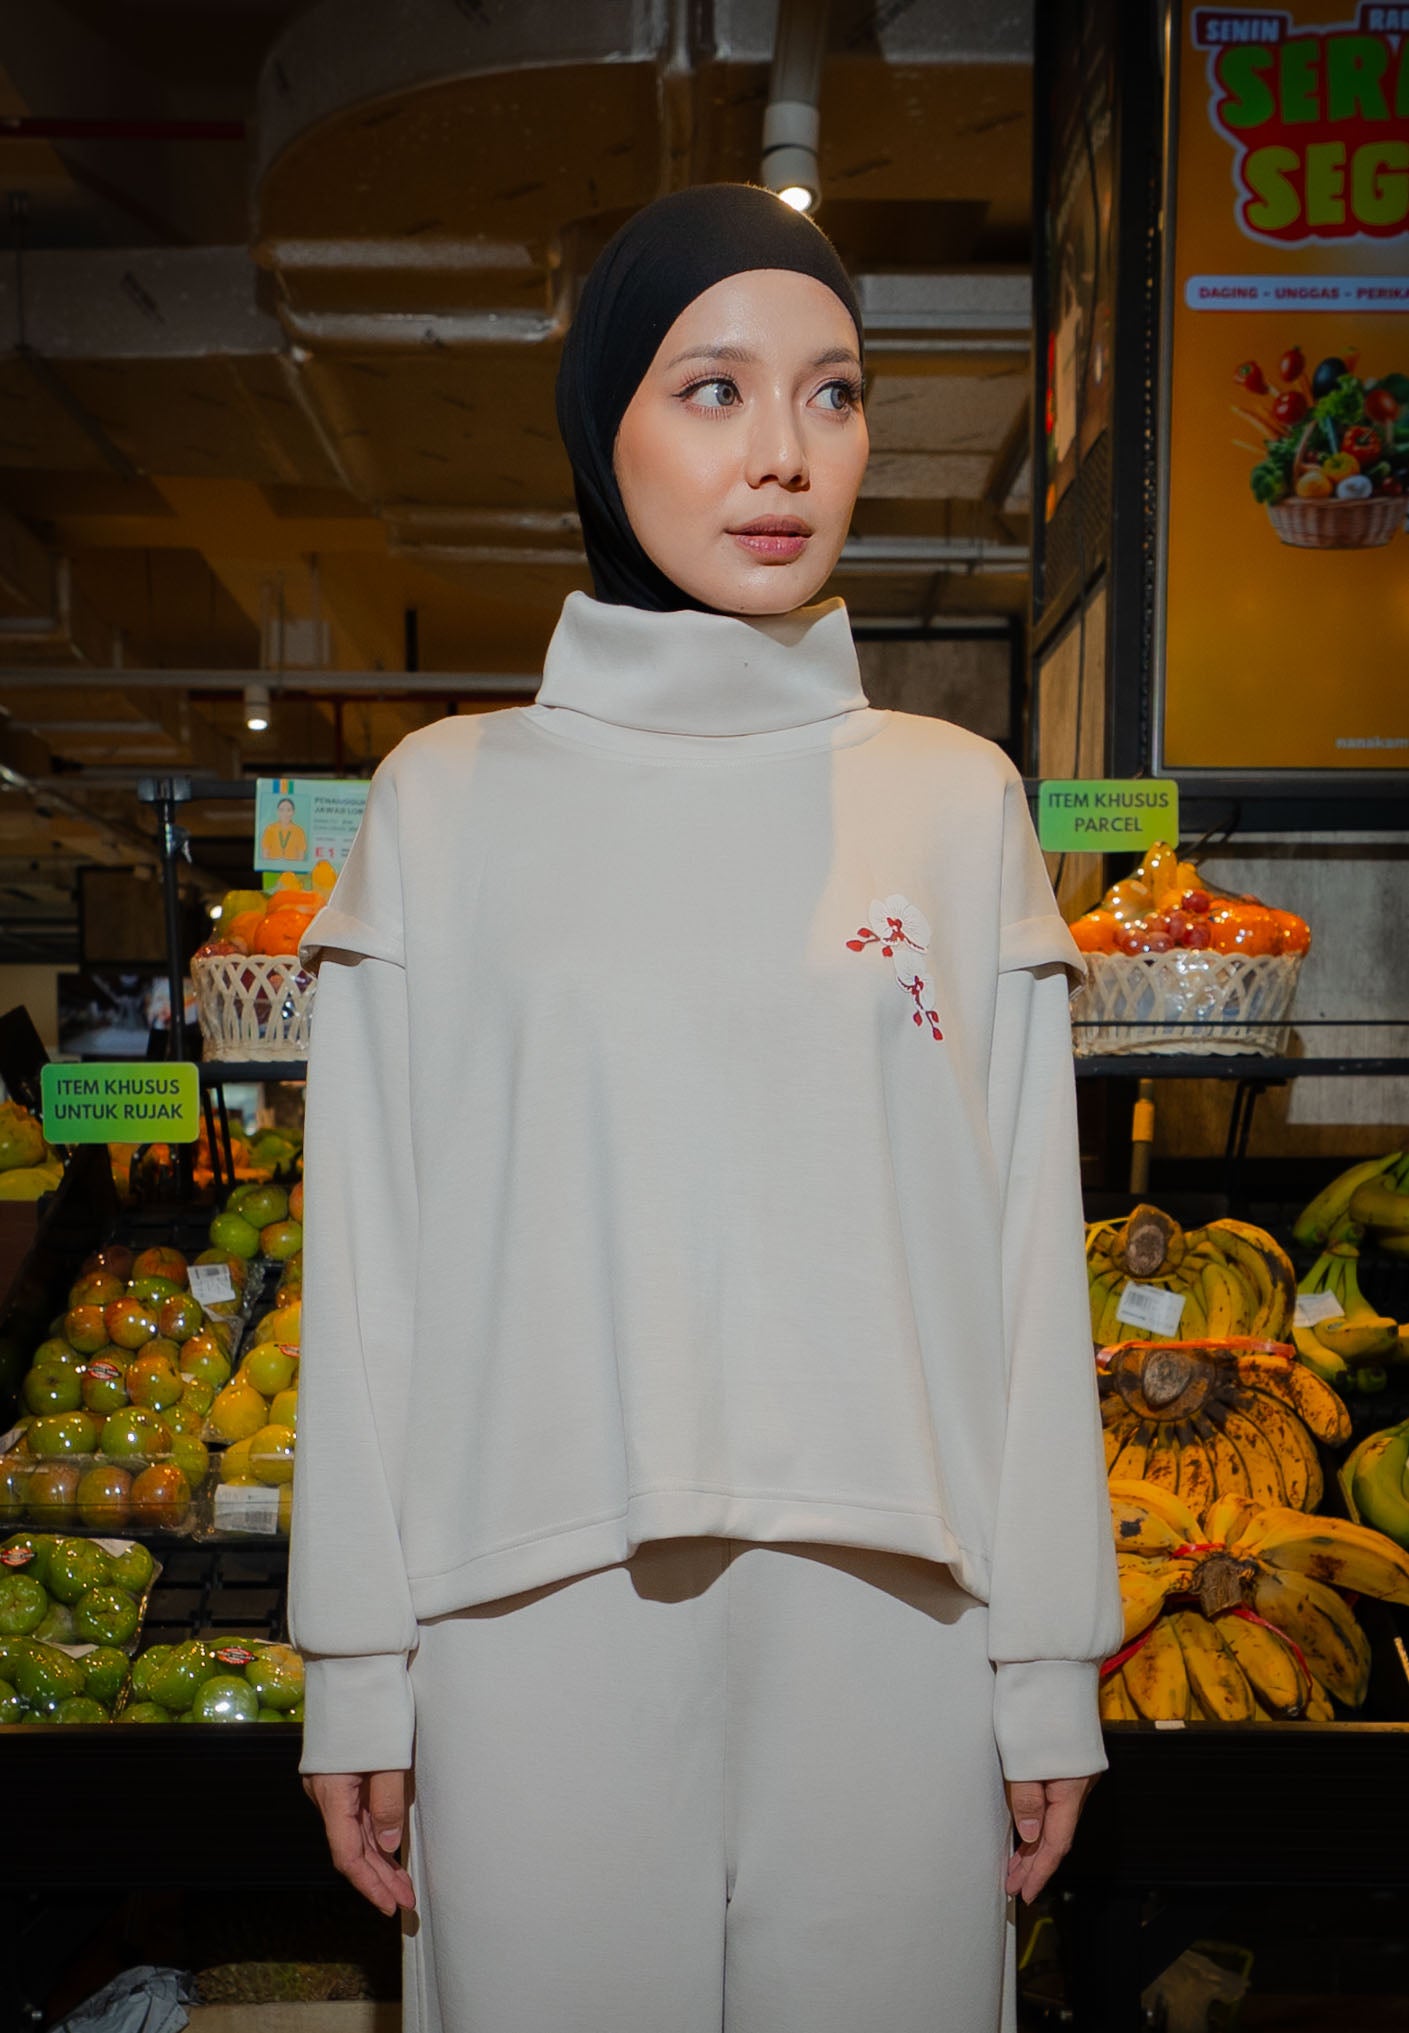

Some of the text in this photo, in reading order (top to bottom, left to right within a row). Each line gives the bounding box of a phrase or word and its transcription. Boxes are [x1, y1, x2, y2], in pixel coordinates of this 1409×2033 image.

[1205, 19, 1280, 43] SENIN
[1221, 36, 1409, 128] SER
[1246, 141, 1409, 230] SEG
[1199, 286, 1258, 299] DAGING
[1274, 286, 1340, 299] UNGGAS
[1048, 792, 1169, 808] ITEM KHUSUS
[1074, 817, 1143, 832] PARCEL
[57, 1079, 180, 1095] ITEM KHUSUS
[54, 1104, 183, 1120] UNTUK RUJAK
